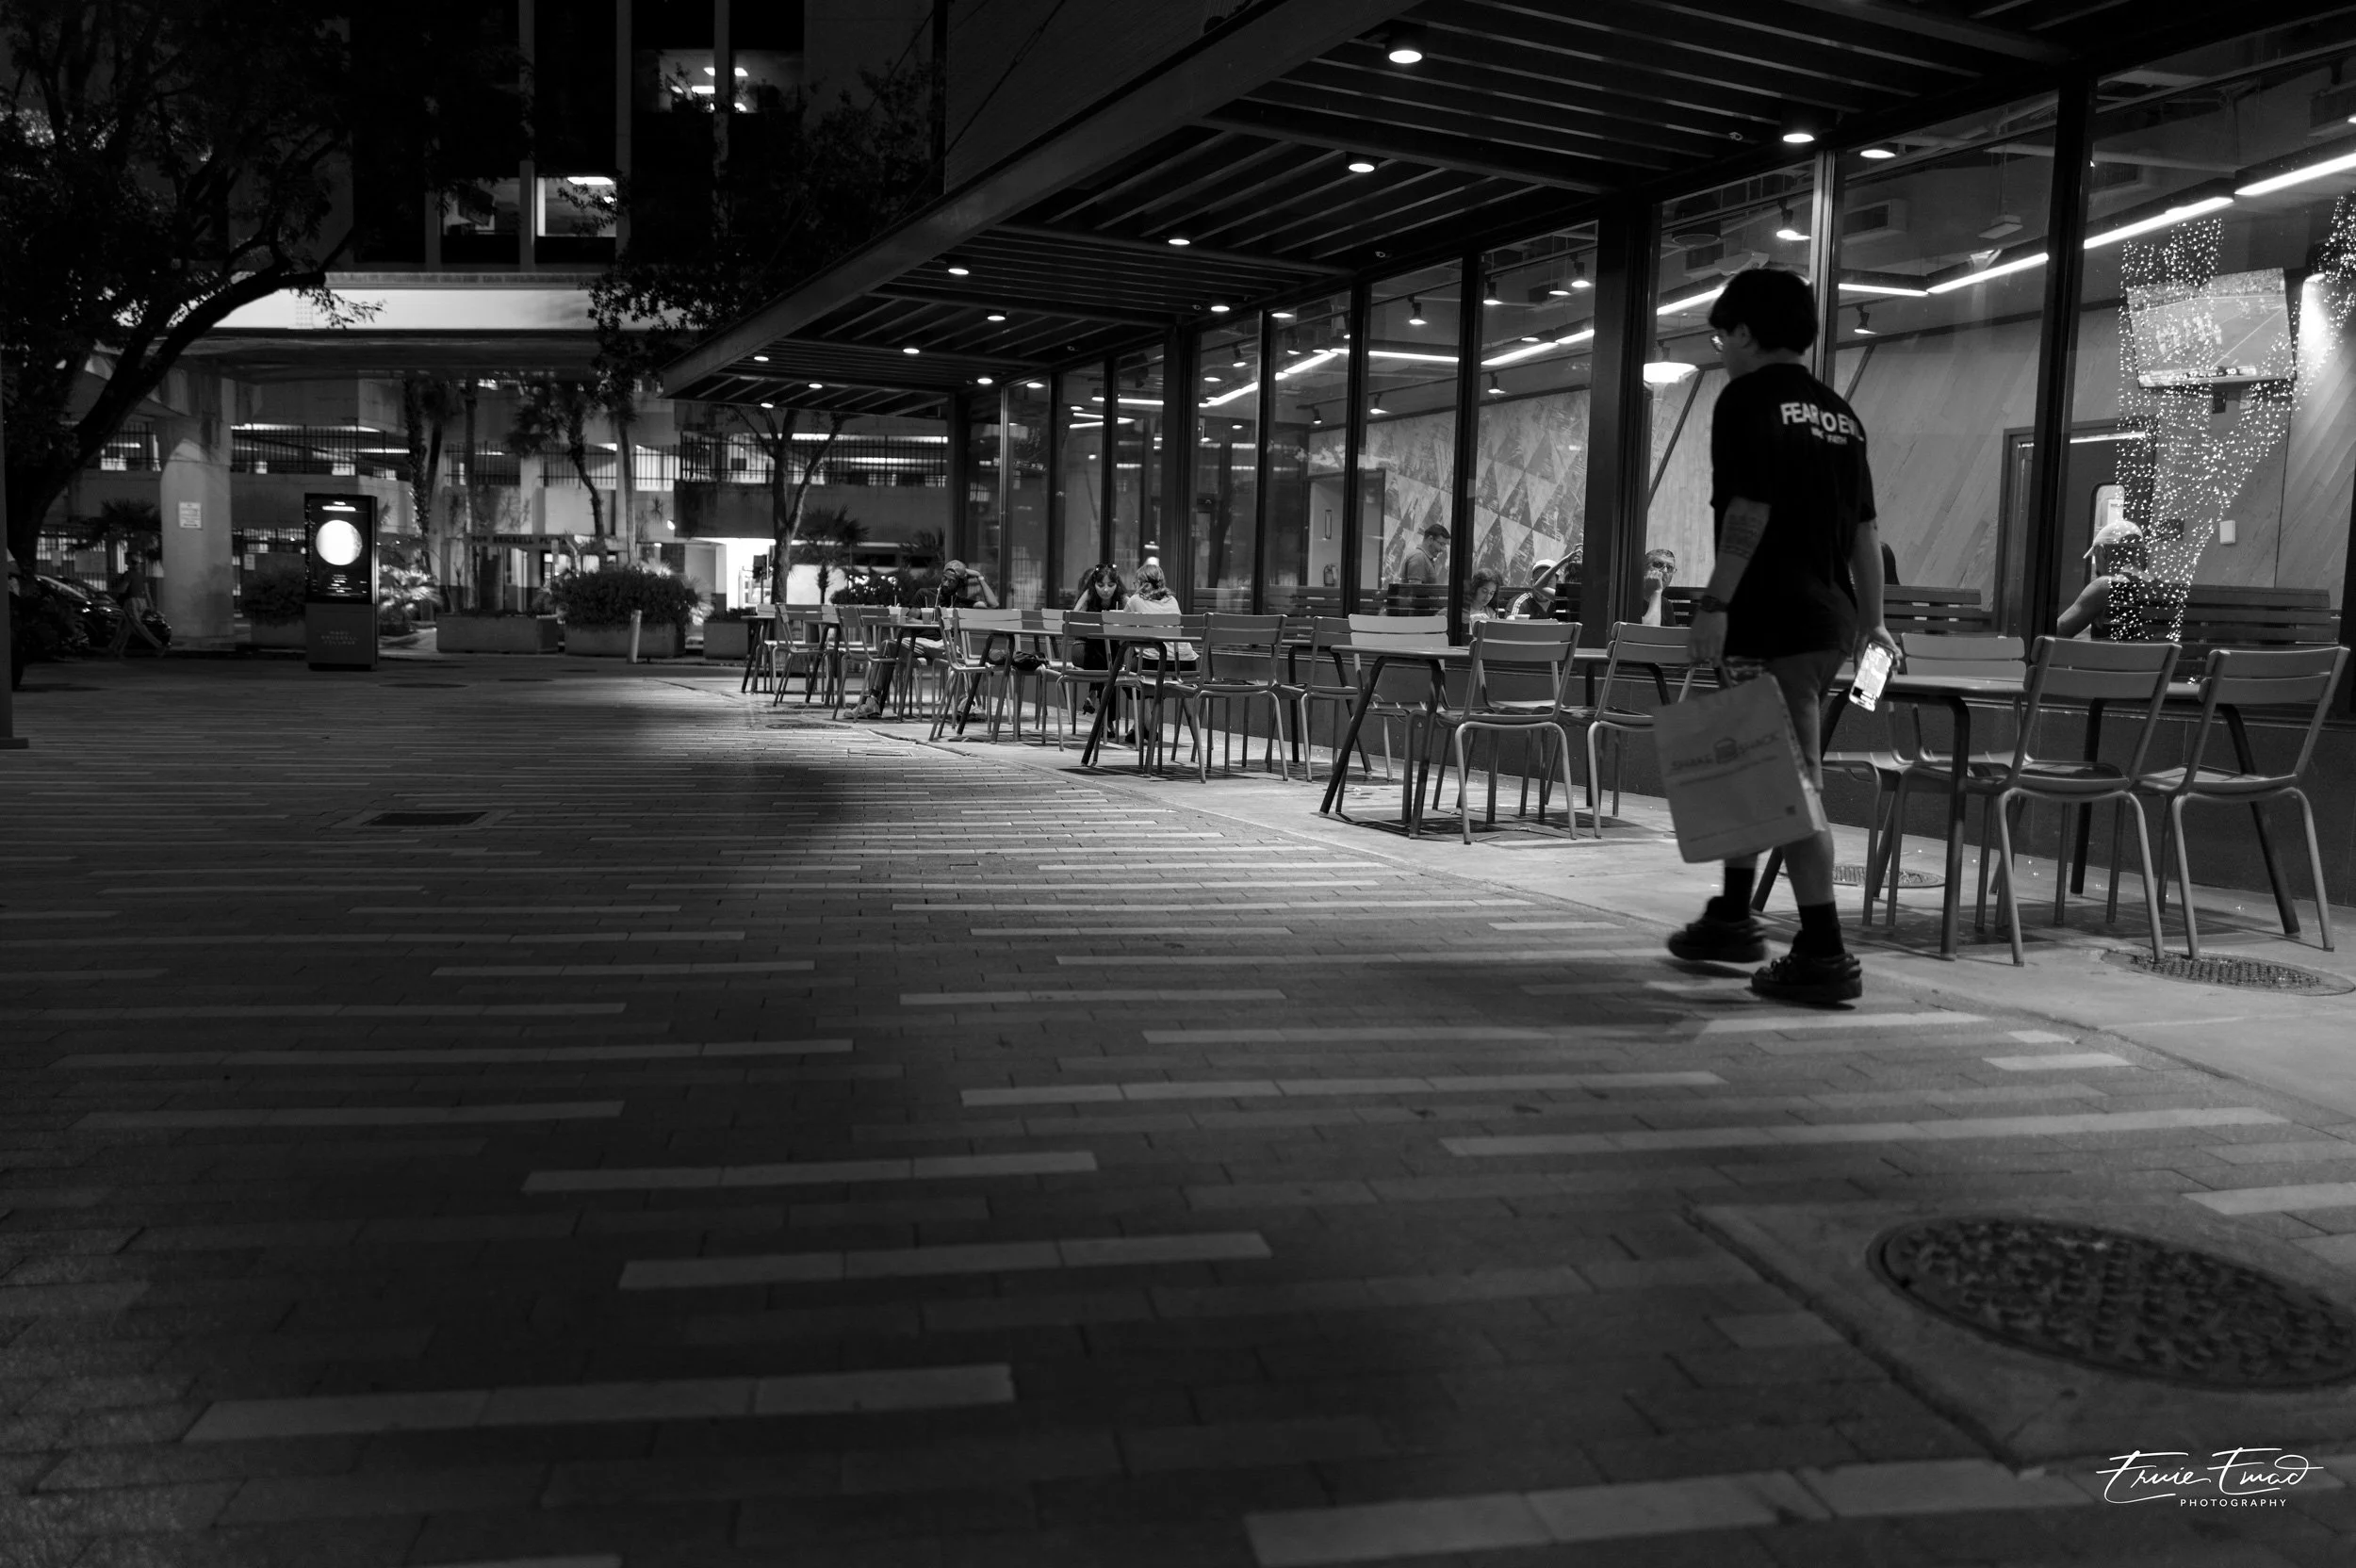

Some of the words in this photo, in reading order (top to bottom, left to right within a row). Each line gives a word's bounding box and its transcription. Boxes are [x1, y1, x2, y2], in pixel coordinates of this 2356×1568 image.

[1779, 402, 1820, 425] FEAR
[1820, 410, 1837, 432] O
[493, 535, 533, 545] BRICKELL
[538, 535, 567, 545] PLZA
